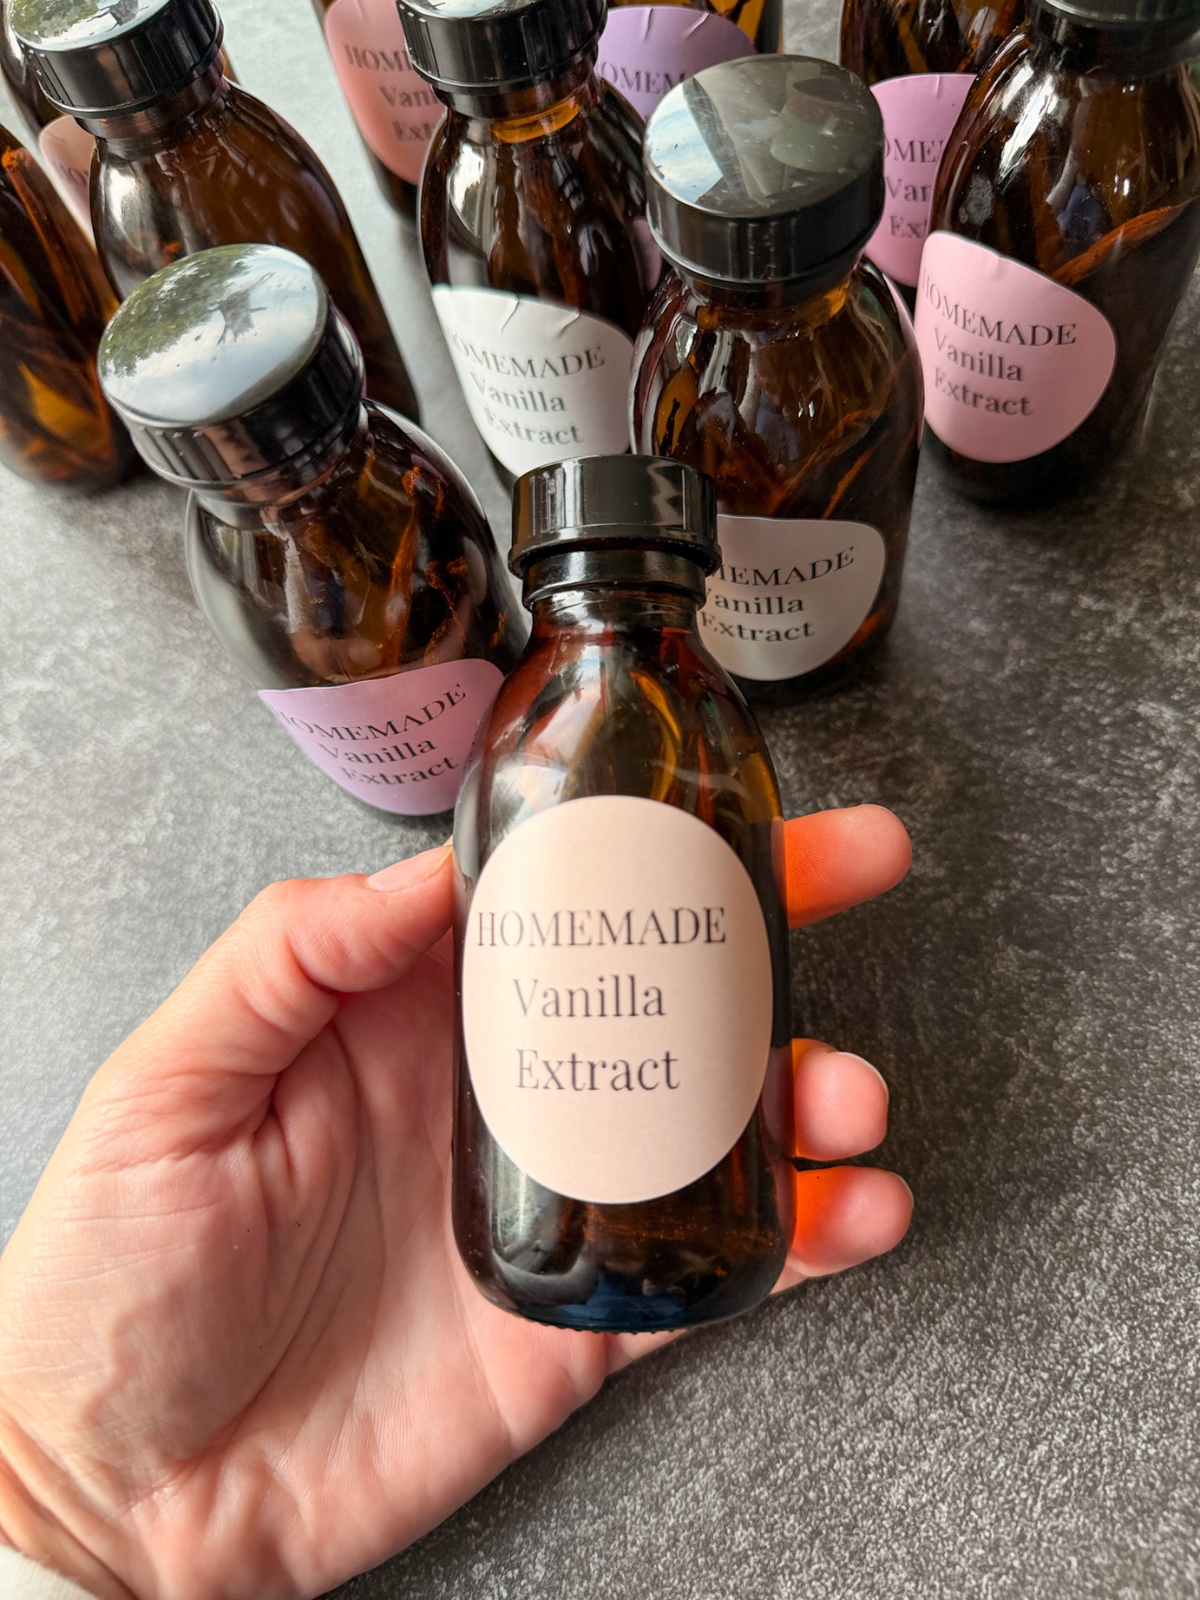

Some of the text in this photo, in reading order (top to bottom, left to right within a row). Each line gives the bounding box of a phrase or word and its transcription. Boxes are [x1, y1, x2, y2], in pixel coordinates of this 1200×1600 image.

[921, 267, 1077, 347] HOMEMADE
[933, 326, 1024, 382] Vanilla
[470, 368, 567, 413] Vanilla
[934, 366, 1032, 417] Extract
[482, 403, 584, 446] Extract
[700, 611, 815, 643] Extract
[318, 738, 438, 765] Vanilla
[340, 755, 460, 786] Extract
[477, 906, 727, 947] HOMEMADE
[512, 973, 667, 1018] Vanilla
[515, 1048, 681, 1092] Extract
